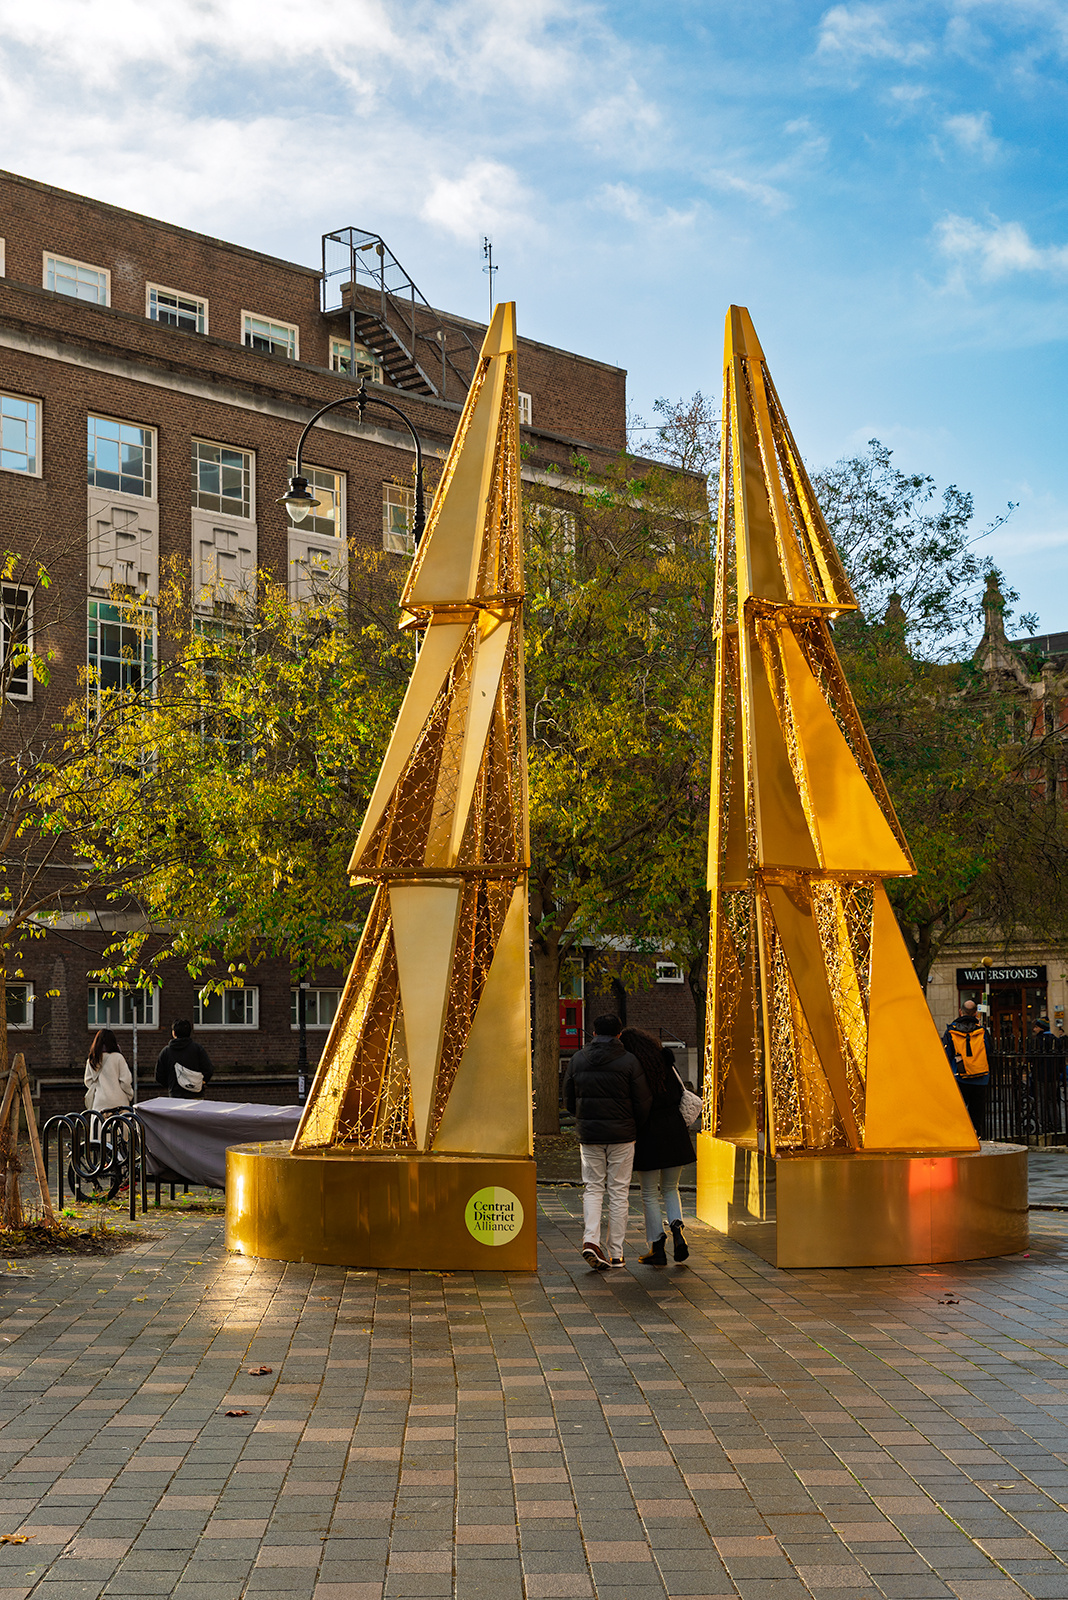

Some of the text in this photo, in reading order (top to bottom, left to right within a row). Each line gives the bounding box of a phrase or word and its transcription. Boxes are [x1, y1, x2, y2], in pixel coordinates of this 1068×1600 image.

[473, 1201, 514, 1211] Central
[474, 1211, 515, 1221] District
[473, 1221, 515, 1231] Alliance
